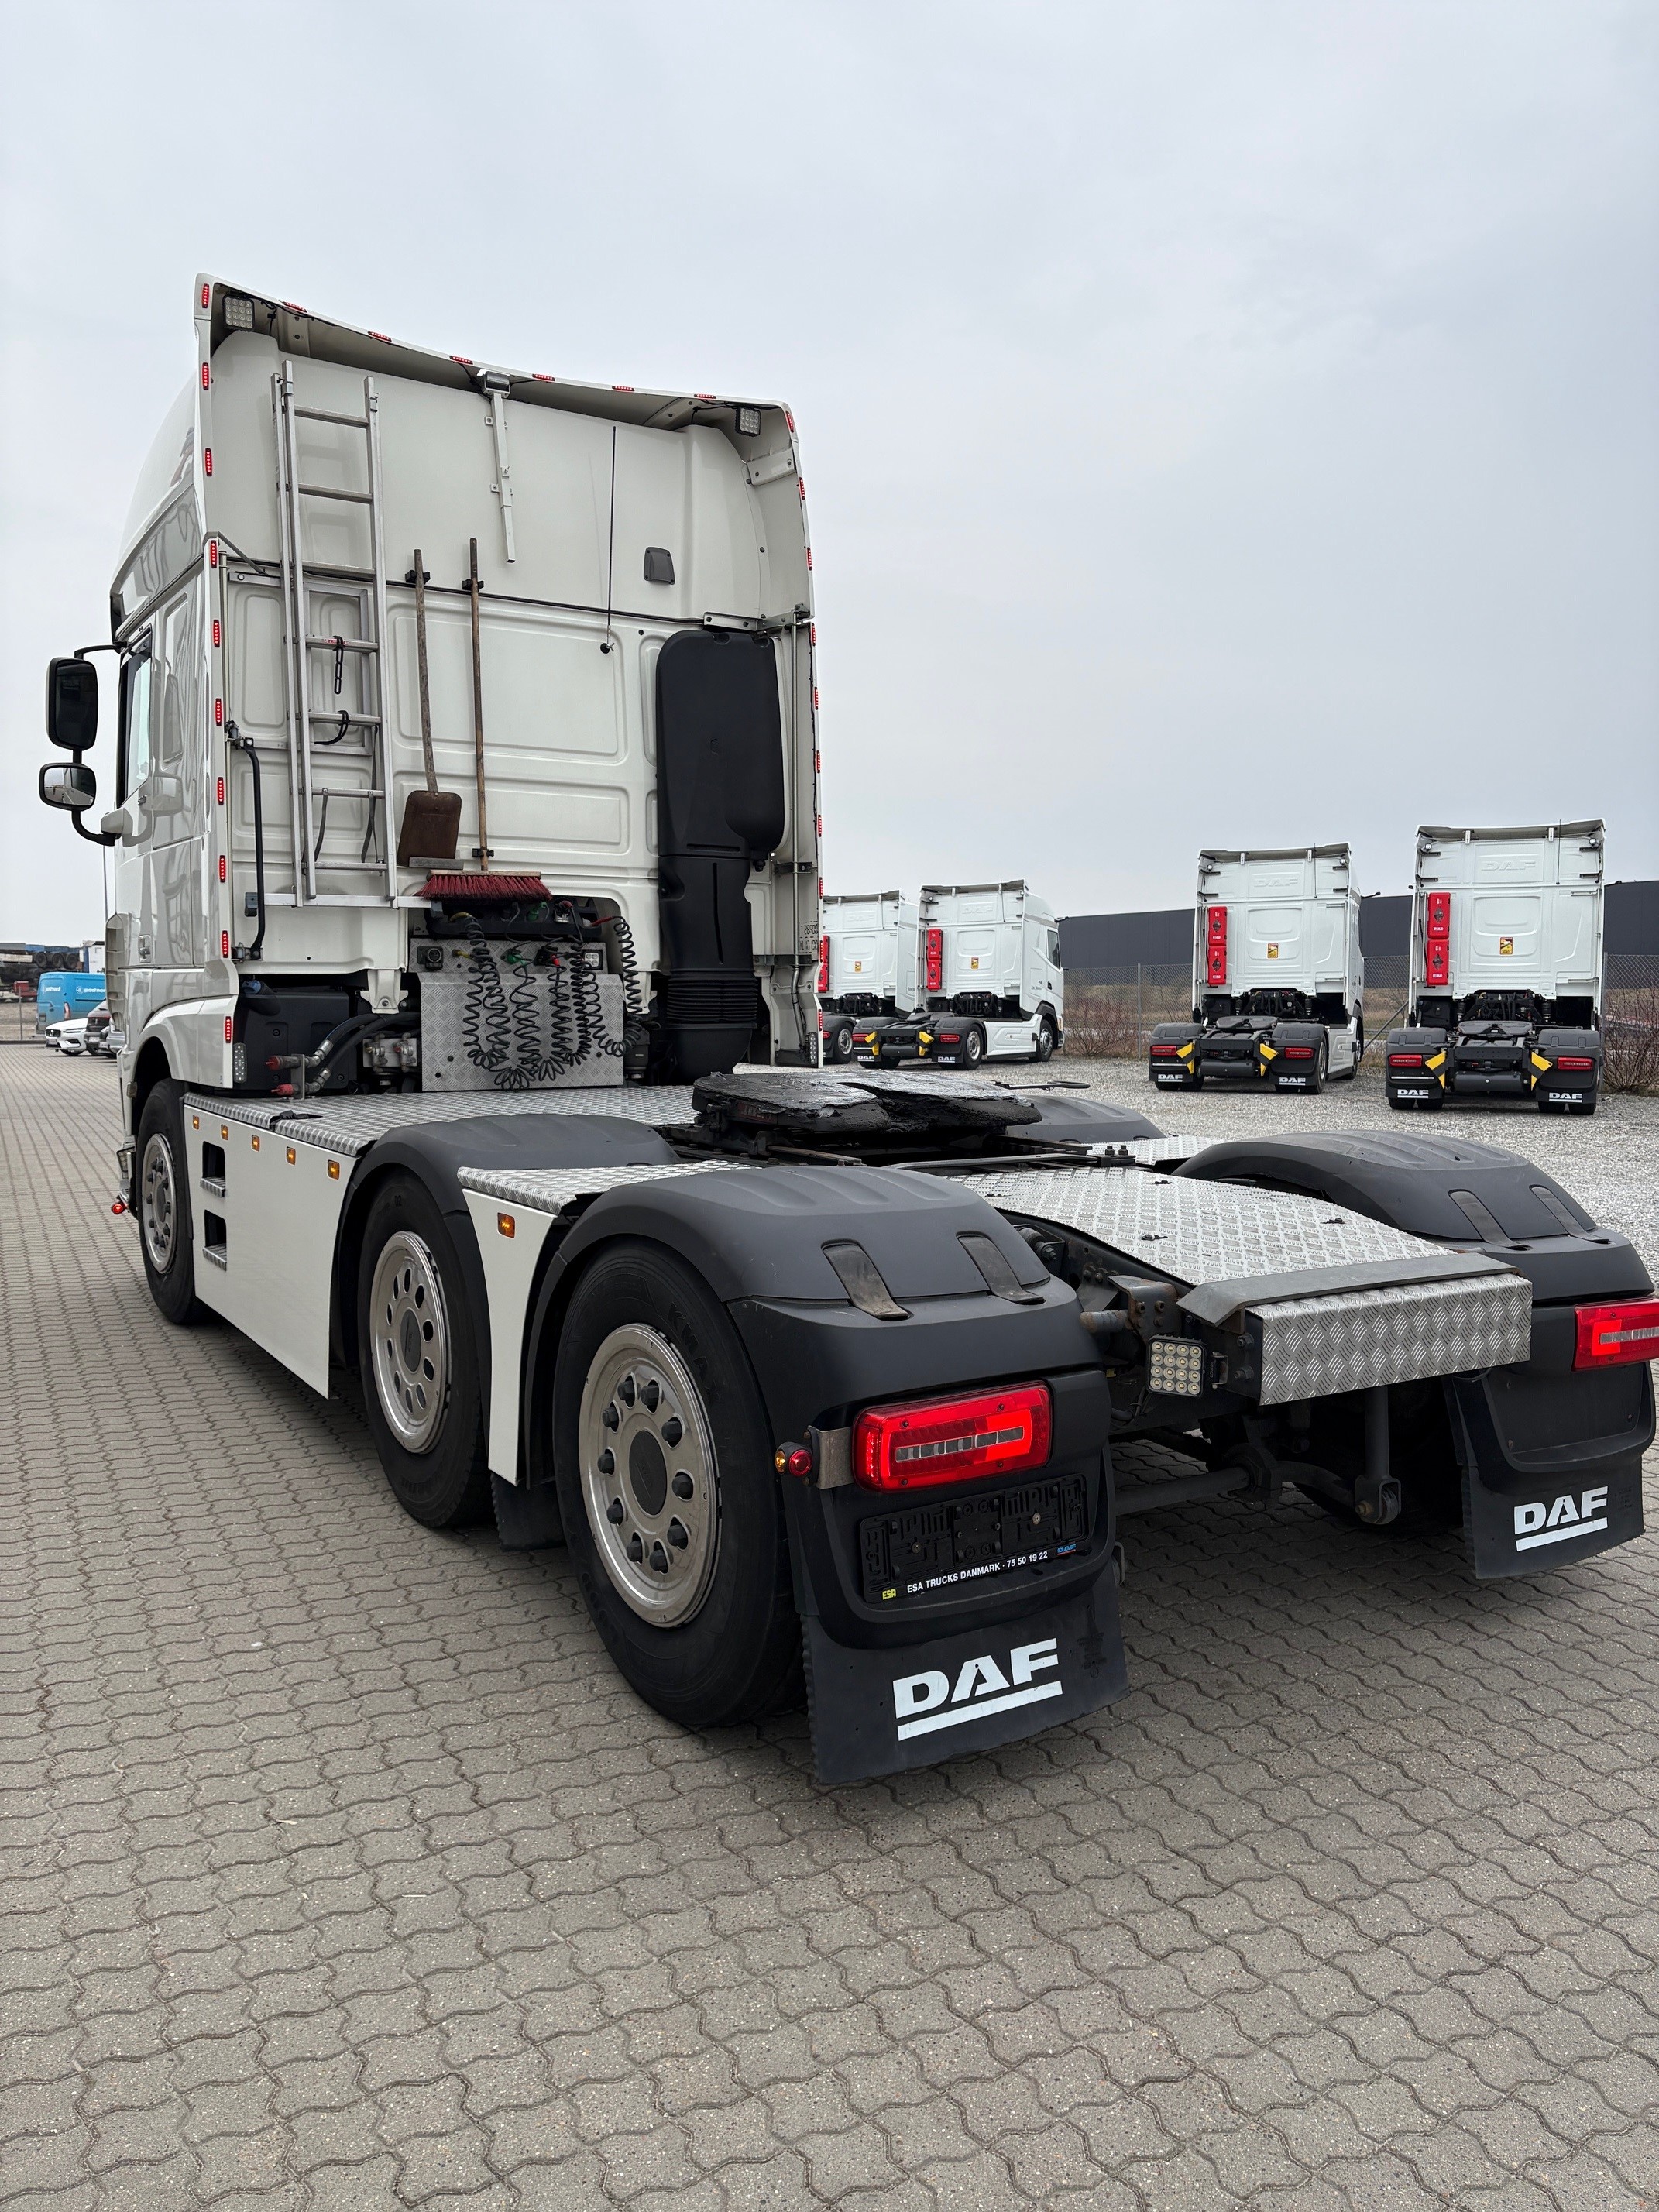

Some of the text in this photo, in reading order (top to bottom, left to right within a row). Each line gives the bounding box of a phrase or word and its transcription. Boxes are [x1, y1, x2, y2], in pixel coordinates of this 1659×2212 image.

[1514, 1486, 1608, 1534] DAF
[1056, 1544, 1077, 1554] DAF
[907, 1551, 1048, 1593] ESA TRUCKS DANMARK 75 50 19 22
[882, 1589, 896, 1600] ESA
[893, 1638, 1058, 1719] DAF
